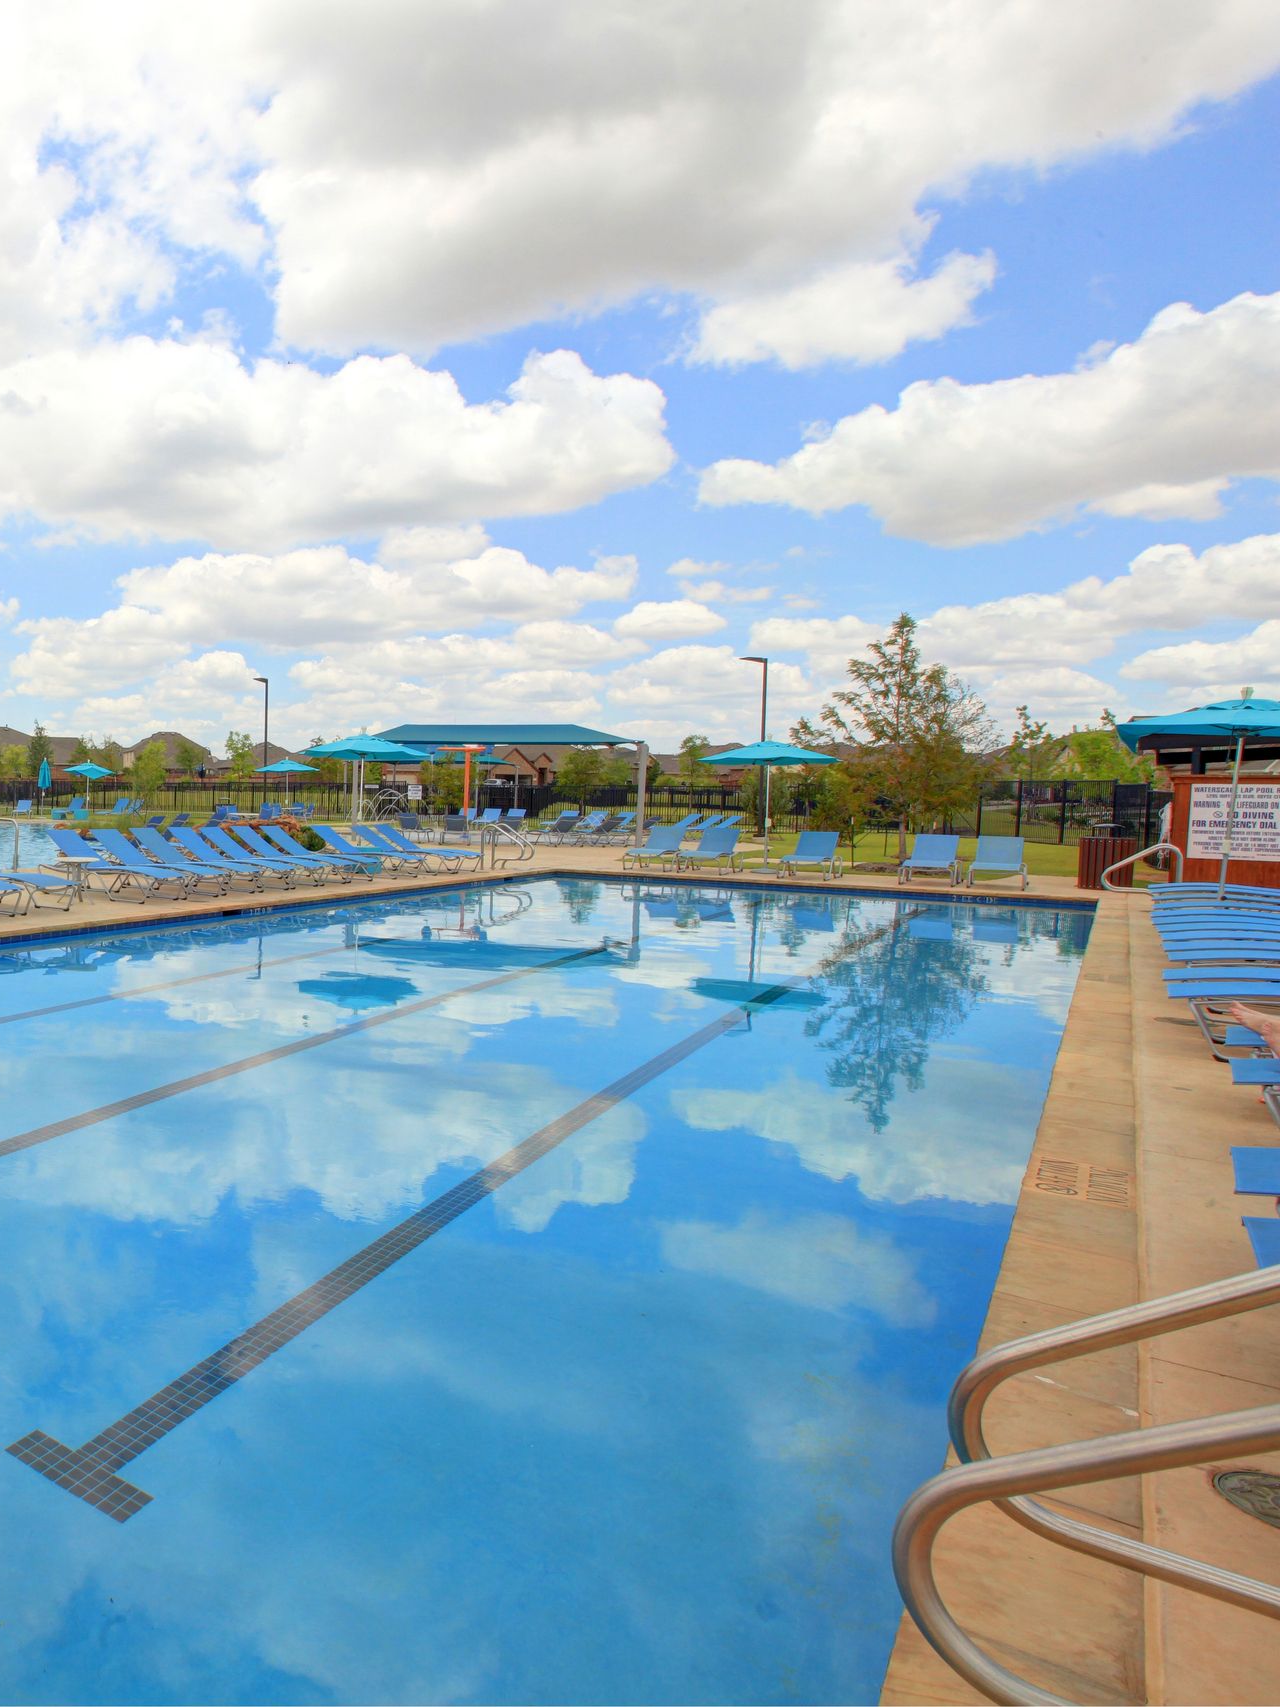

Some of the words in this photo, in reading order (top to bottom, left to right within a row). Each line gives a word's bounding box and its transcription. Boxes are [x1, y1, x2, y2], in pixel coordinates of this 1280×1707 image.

[1192, 820, 1207, 828] FOR
[1209, 820, 1257, 829] EMEGENCY
[1259, 821, 1278, 830] DIAL
